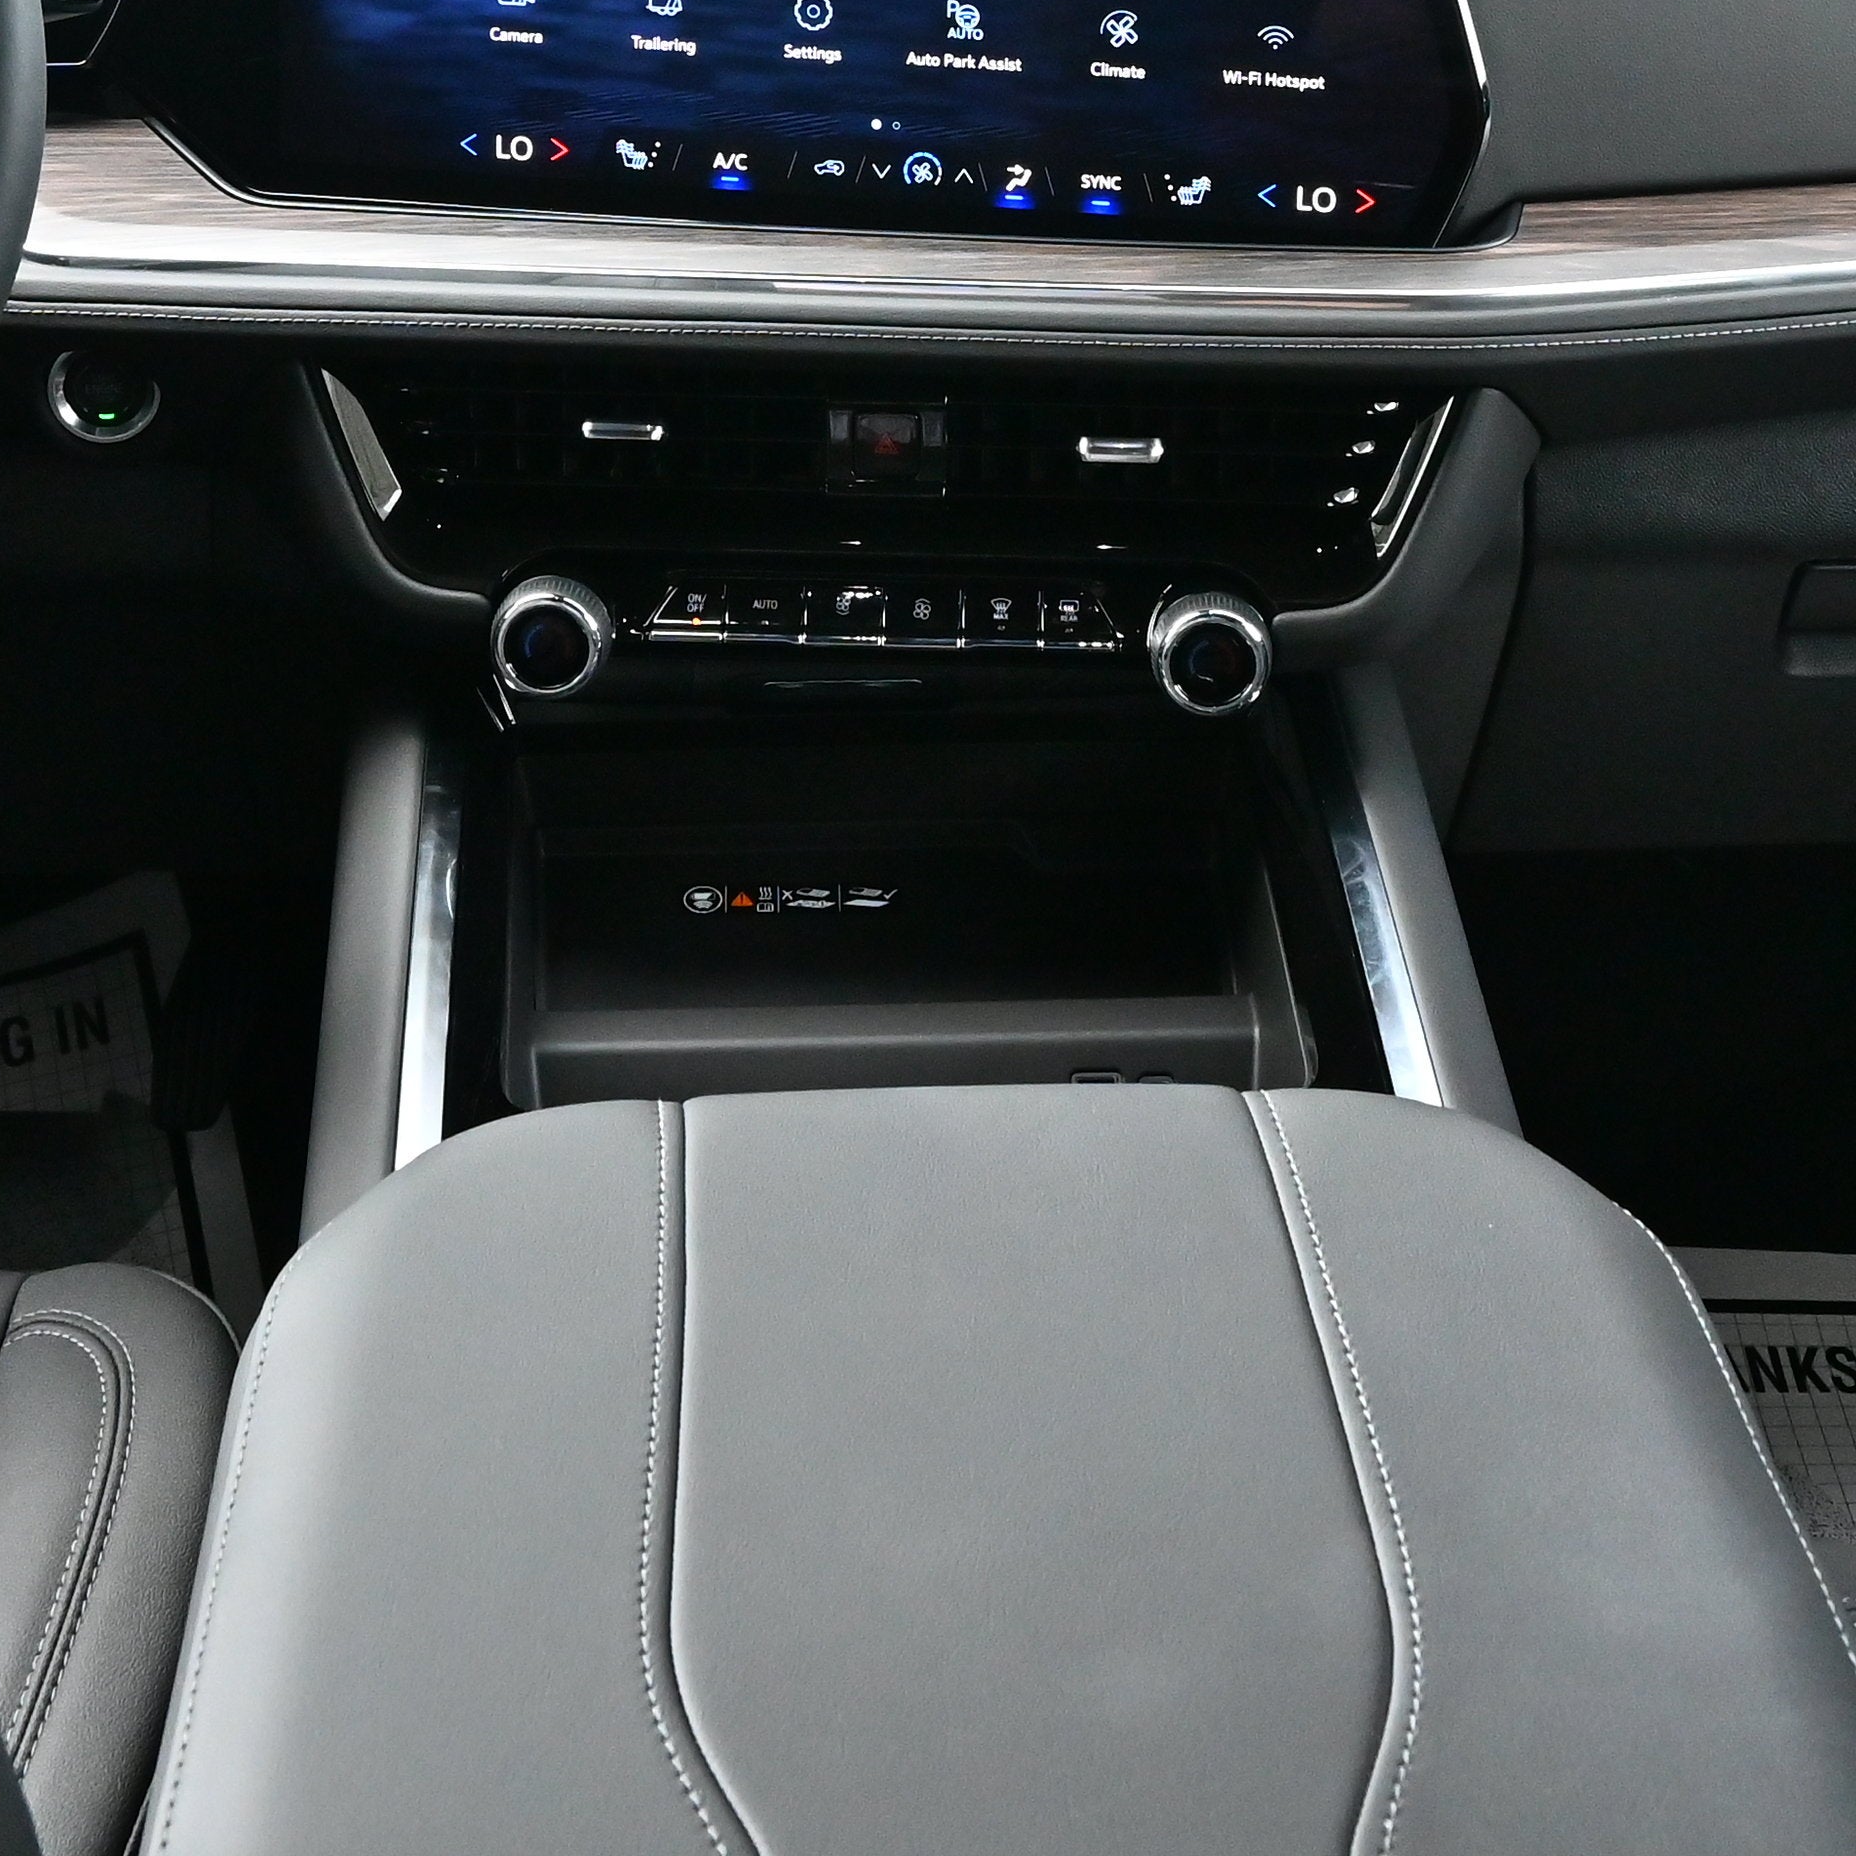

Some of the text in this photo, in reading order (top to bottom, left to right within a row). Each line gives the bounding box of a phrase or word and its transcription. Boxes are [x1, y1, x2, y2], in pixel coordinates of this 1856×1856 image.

[489, 27, 543, 45] Camera
[631, 35, 697, 56] Trailering
[783, 44, 842, 64] Settings
[906, 51, 1023, 73] Auto Park Assist
[1090, 62, 1146, 81] Climate
[1222, 69, 1326, 92] Wi-Fi Hotspot
[495, 134, 533, 162] LO
[713, 151, 748, 172] A/C
[1081, 173, 1122, 192] SYNC
[1296, 184, 1338, 213] LO
[686, 602, 706, 613] OFF
[687, 592, 707, 603] ON/
[752, 598, 779, 611] AUTO
[54, 995, 111, 1055] IN
